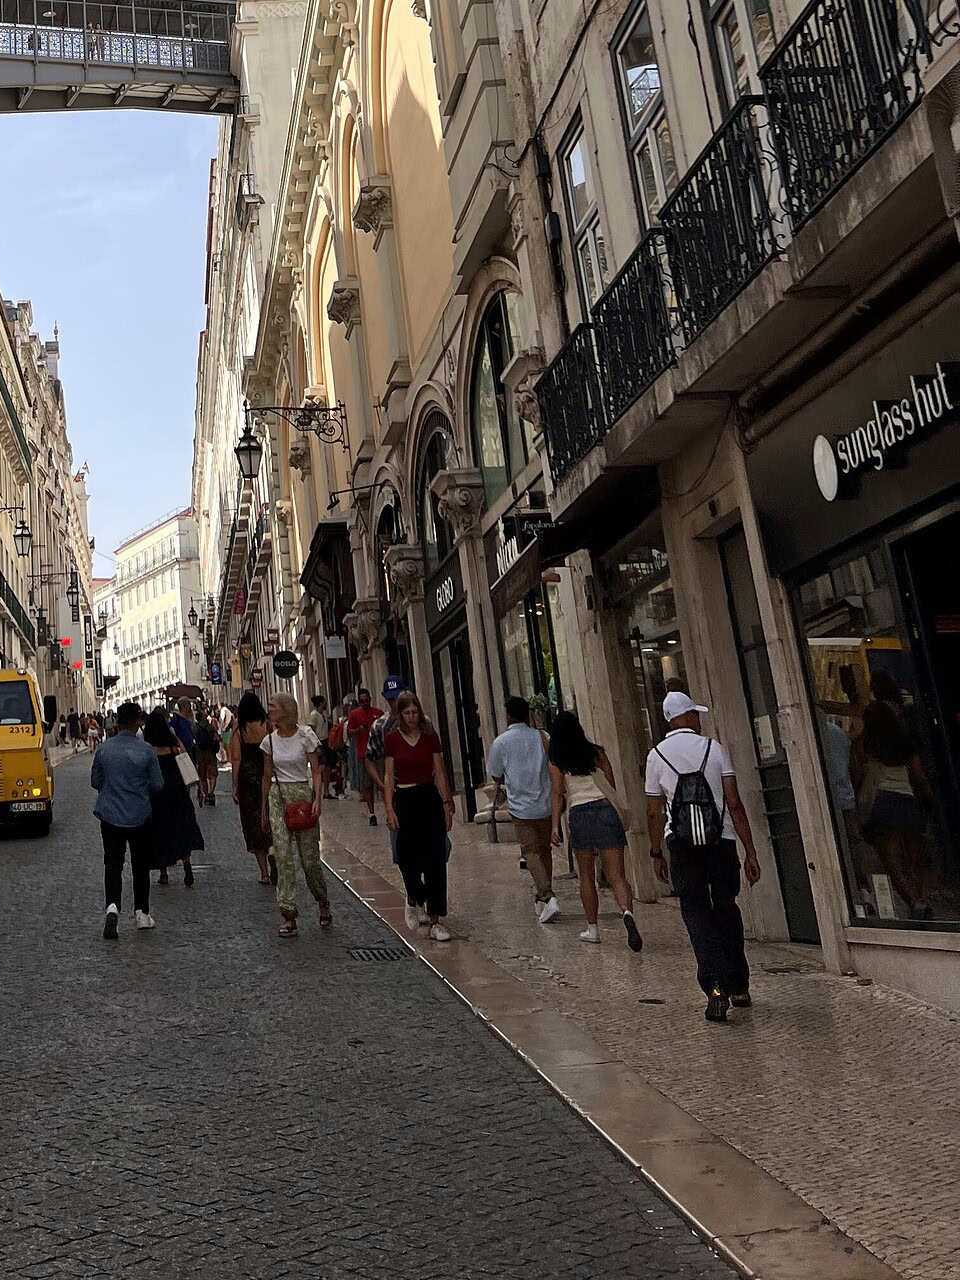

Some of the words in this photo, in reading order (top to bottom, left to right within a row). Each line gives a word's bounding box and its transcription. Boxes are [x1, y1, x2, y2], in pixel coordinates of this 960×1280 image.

[837, 399, 915, 474] sunglass
[909, 362, 954, 427] hut
[436, 576, 454, 613] GLOBO
[9, 726, 31, 734] 2312
